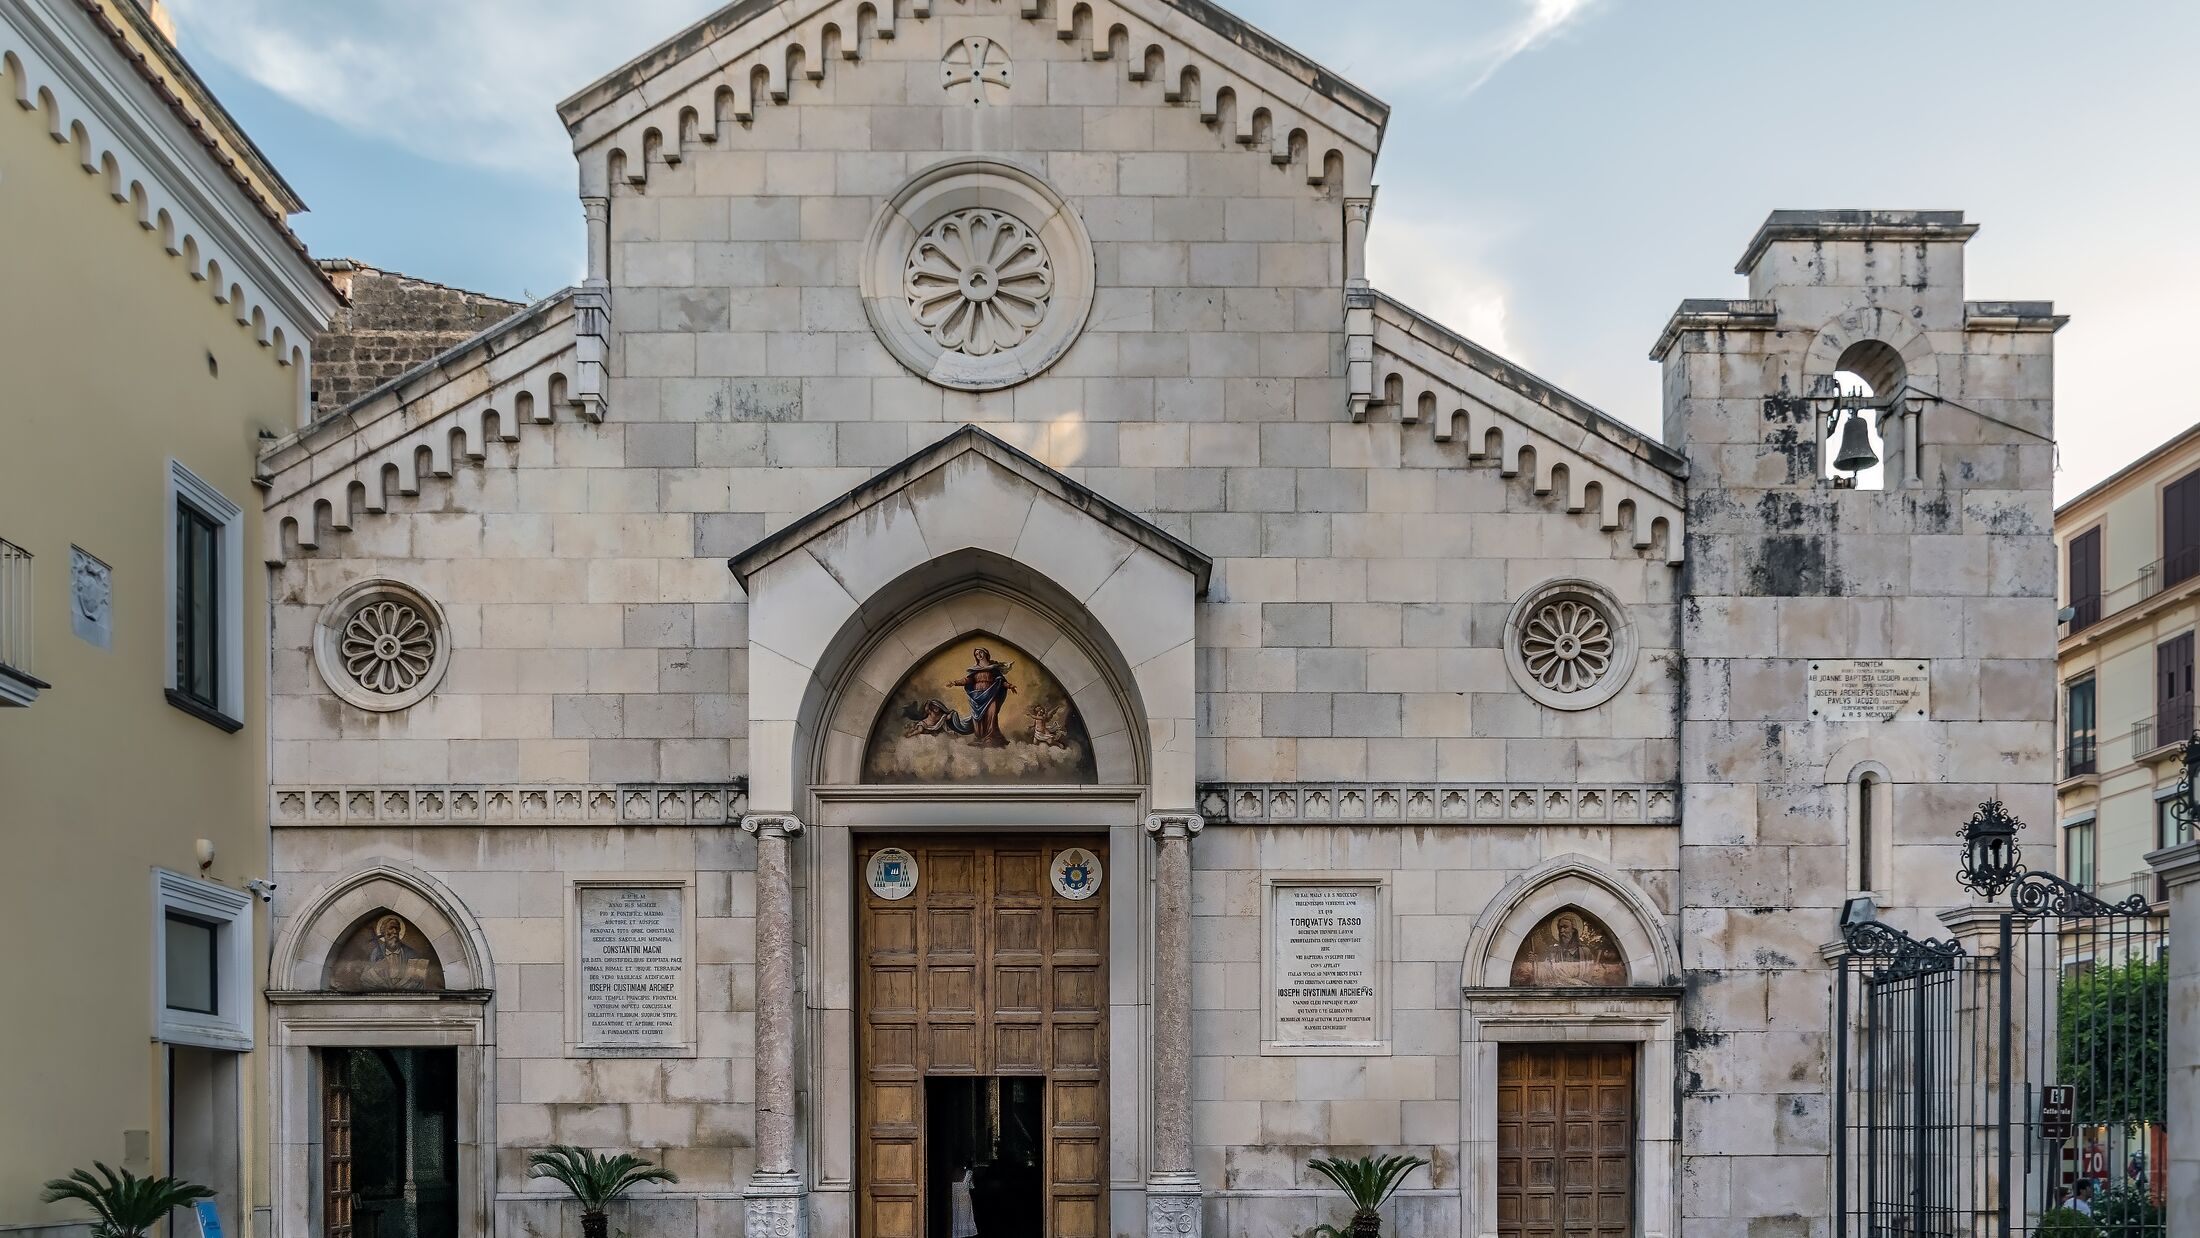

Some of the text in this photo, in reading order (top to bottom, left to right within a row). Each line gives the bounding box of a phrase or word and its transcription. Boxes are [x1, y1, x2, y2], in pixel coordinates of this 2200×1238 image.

[1290, 918, 1361, 928] TORQVATVS TASSO
[603, 946, 662, 954] CONSTANTINI MAGNI
[589, 984, 611, 992] IOSEPH
[649, 984, 674, 992] ARCHIEP
[1278, 988, 1300, 997] IOSEPH
[1303, 988, 1337, 997] GIVSTINIANI
[2085, 1152, 2103, 1173] 70
